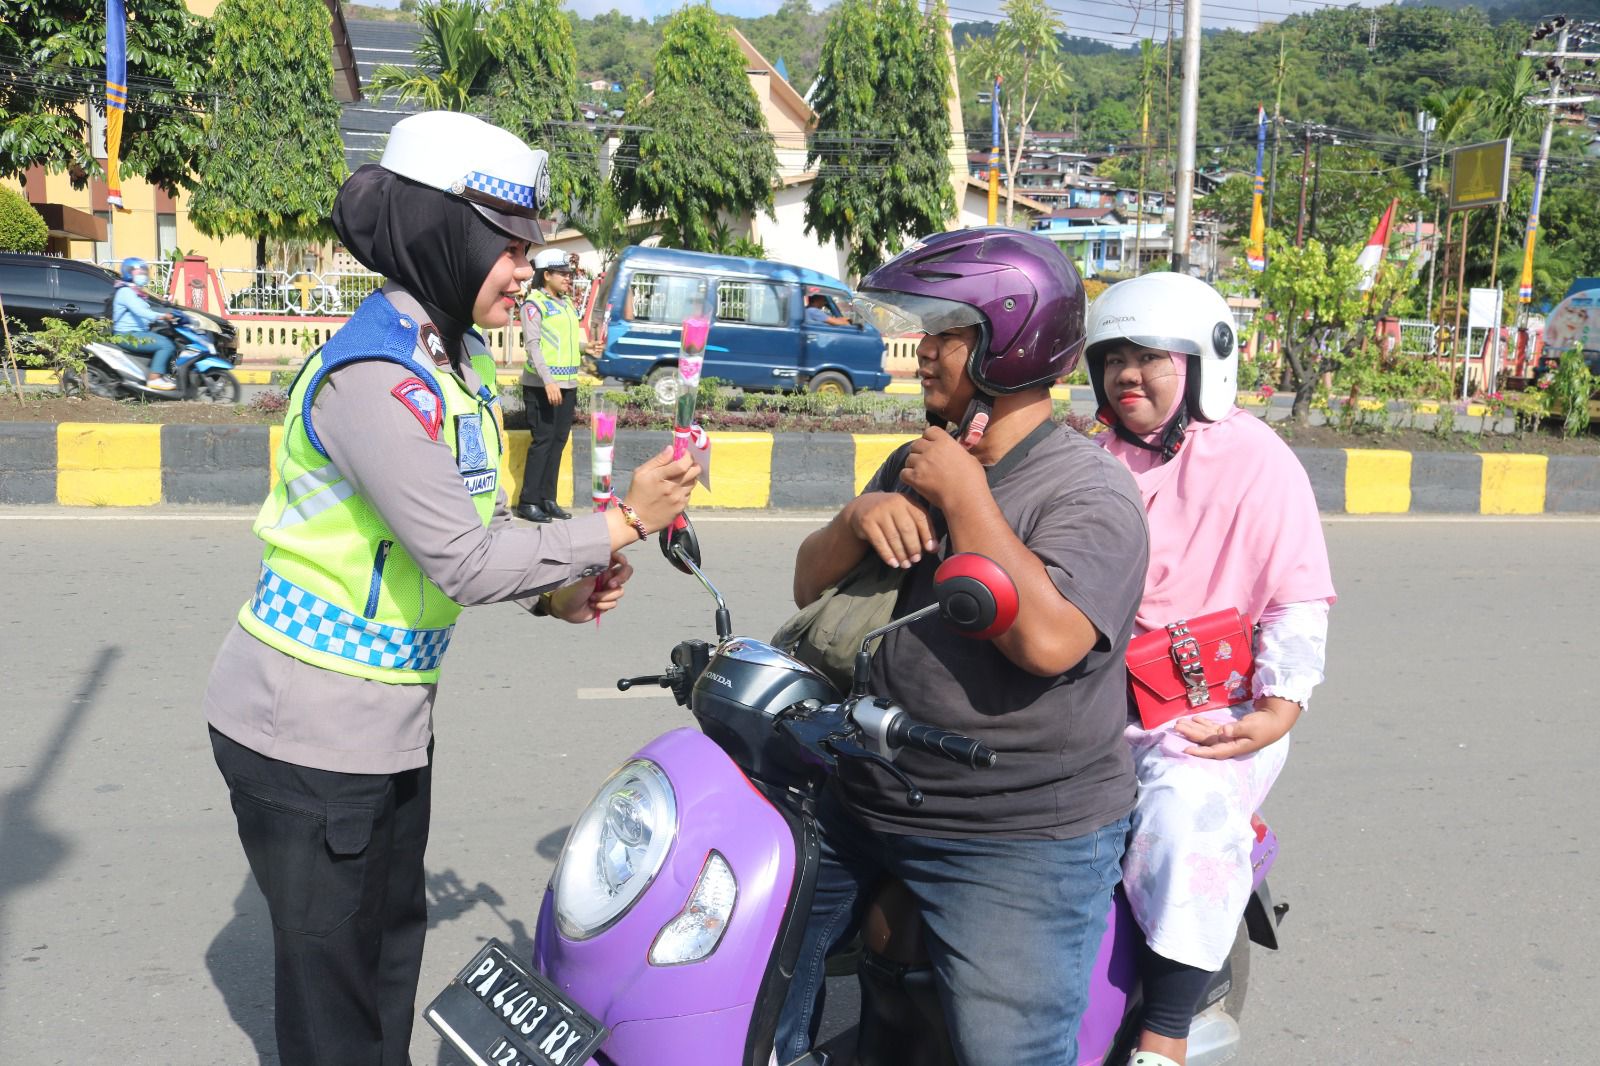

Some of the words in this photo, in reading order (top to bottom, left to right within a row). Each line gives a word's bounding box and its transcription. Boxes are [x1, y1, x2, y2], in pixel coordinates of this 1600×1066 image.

[467, 957, 503, 997] PA
[492, 981, 548, 1035] 4403
[538, 1020, 581, 1065] RX
